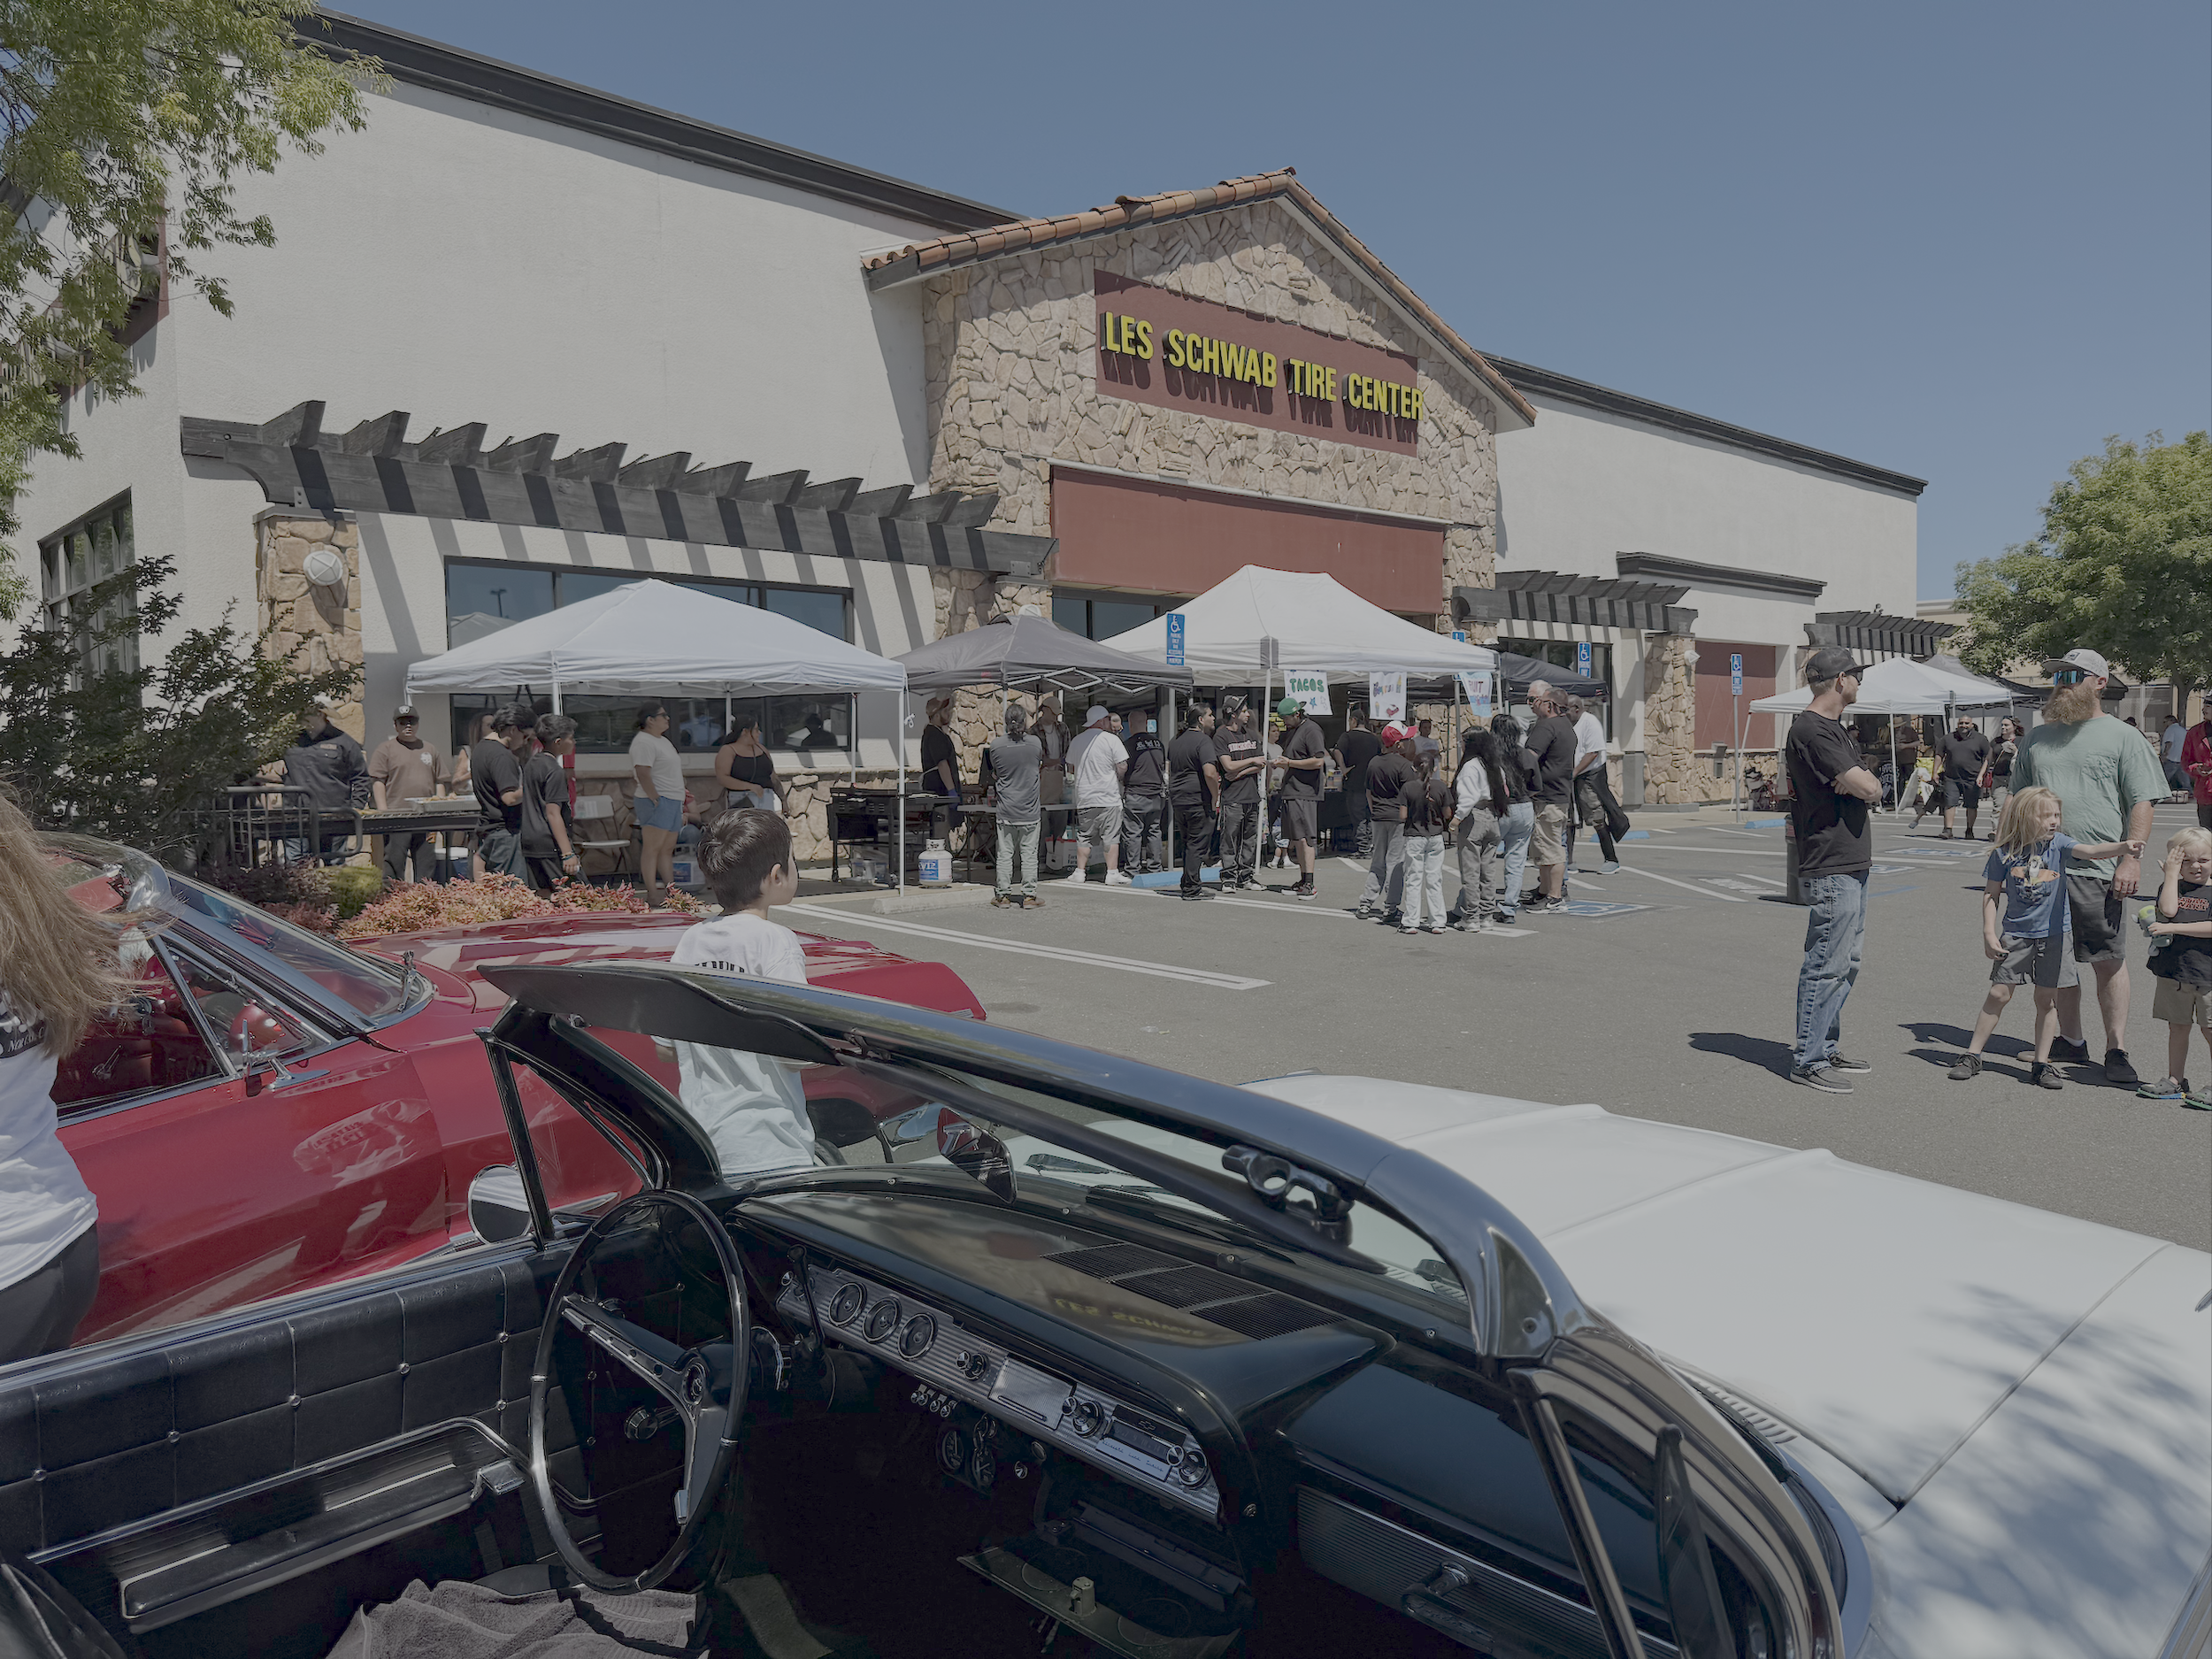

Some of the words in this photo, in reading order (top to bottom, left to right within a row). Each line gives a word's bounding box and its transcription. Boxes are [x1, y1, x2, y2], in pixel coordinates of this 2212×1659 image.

[1102, 311, 1154, 360] LES
[1165, 327, 1278, 389] SCHWAB
[1286, 357, 1338, 403] TIRE
[1346, 373, 1424, 421] CENTER
[1289, 678, 1325, 693] TACOS
